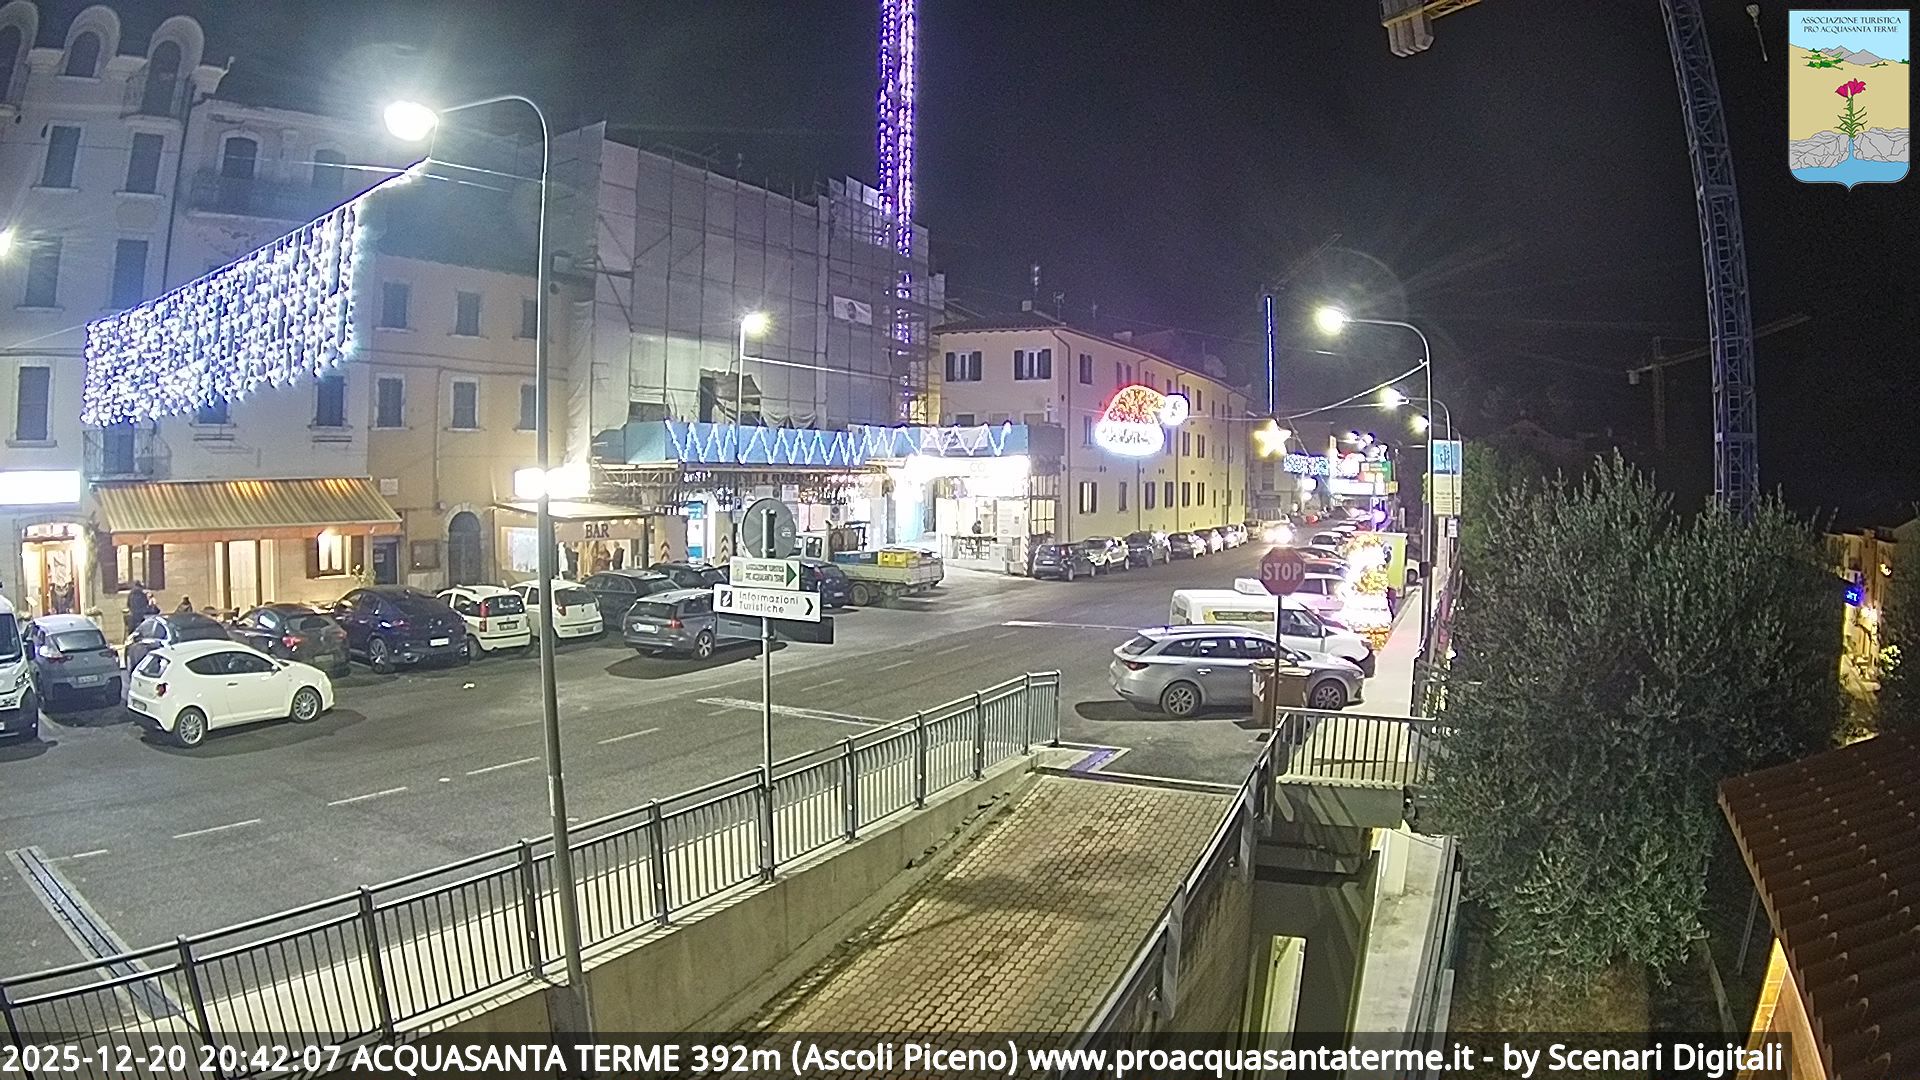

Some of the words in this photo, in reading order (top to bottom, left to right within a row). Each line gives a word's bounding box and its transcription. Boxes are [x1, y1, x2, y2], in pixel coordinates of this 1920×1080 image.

[585, 523, 610, 539] BAR
[1263, 562, 1302, 581] STOP
[739, 591, 799, 605] Informazioni
[739, 601, 785, 614] Turistiche
